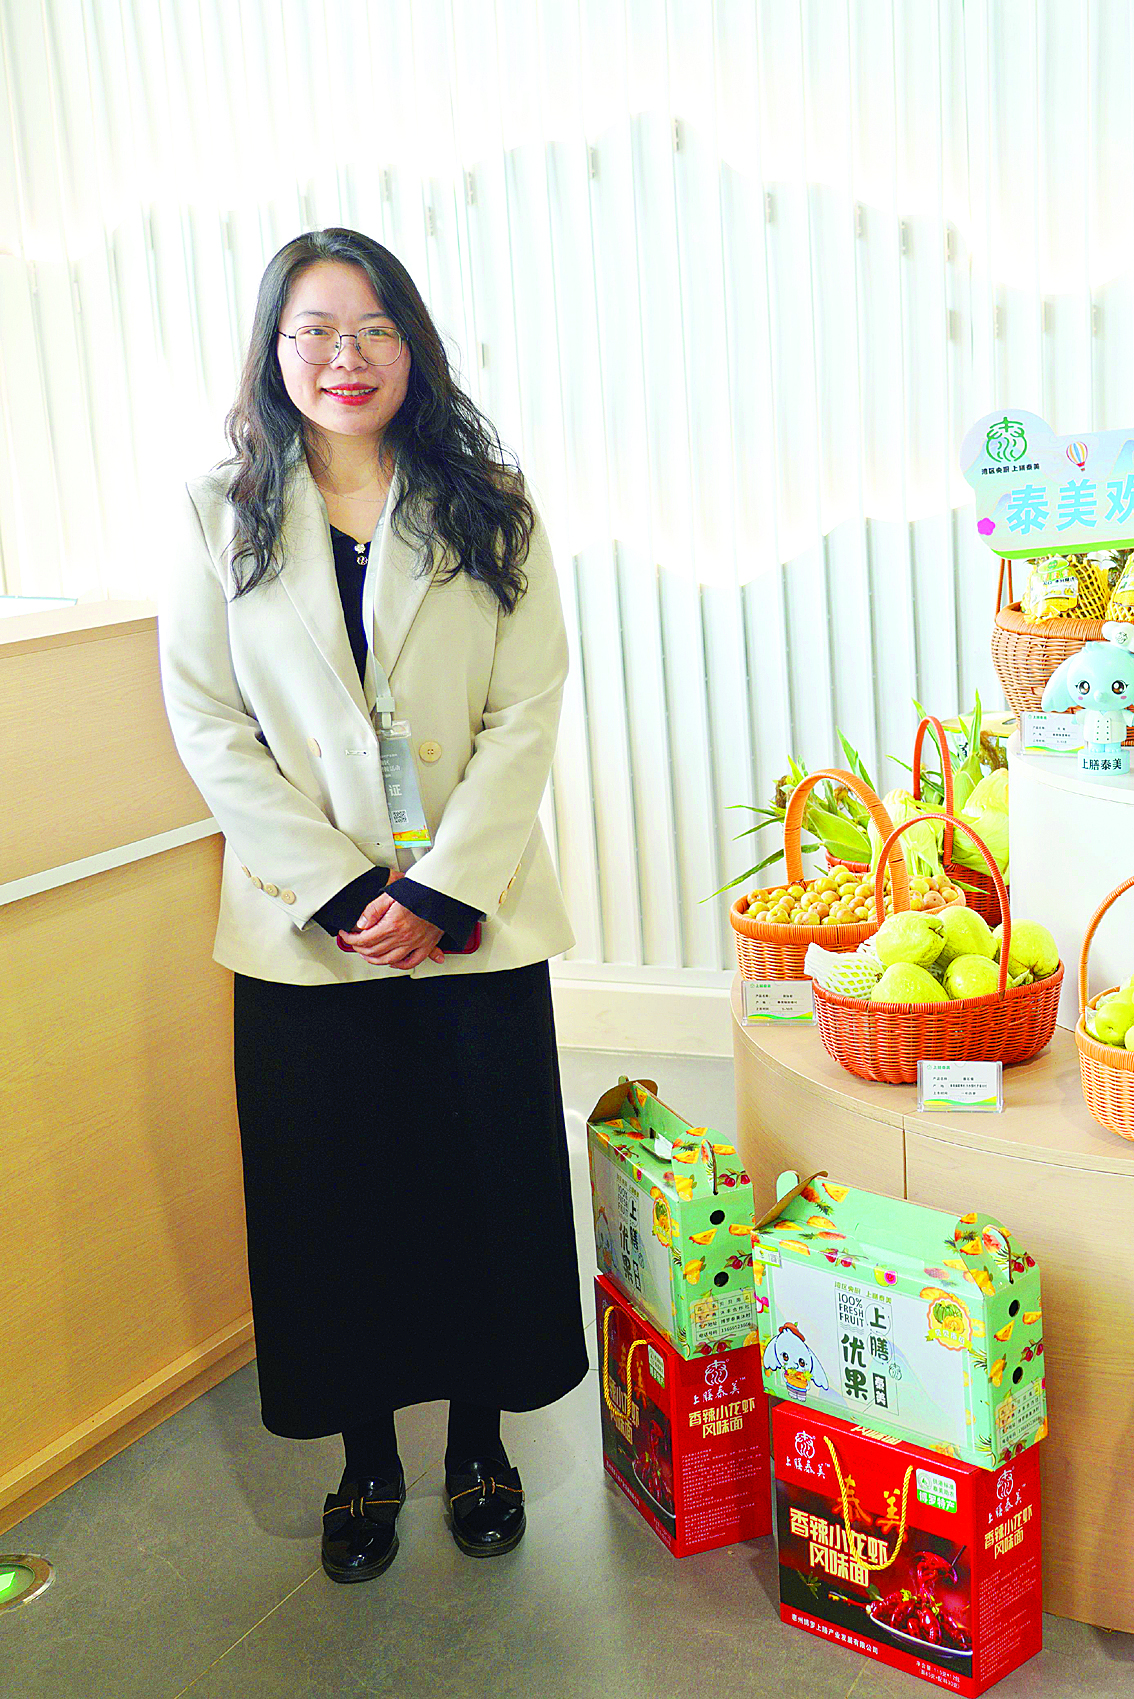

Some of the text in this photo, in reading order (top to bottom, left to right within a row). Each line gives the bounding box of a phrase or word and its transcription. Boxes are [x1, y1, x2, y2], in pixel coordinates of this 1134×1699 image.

[1082, 758, 1122, 771] 上膳泰美
[838, 1292, 863, 1309] 100%
[838, 1302, 864, 1318] FRESH
[839, 1312, 864, 1328] FRUIT
[870, 1307, 889, 1362] 上膳
[840, 1334, 868, 1400] 优果
[692, 1380, 740, 1406] 上膳泰美
[688, 1397, 756, 1428] 香辣小龙虾
[702, 1415, 744, 1439] 风味面
[785, 1456, 826, 1480] 上膳泰美
[832, 1474, 909, 1543] 泰美
[919, 1490, 955, 1510] 博罗特产
[789, 1507, 888, 1566] 香辣小龙虾
[984, 1504, 1033, 1550] 香辣小龙虾
[994, 1526, 1024, 1560] 风味面
[809, 1541, 870, 1588] 风味面
